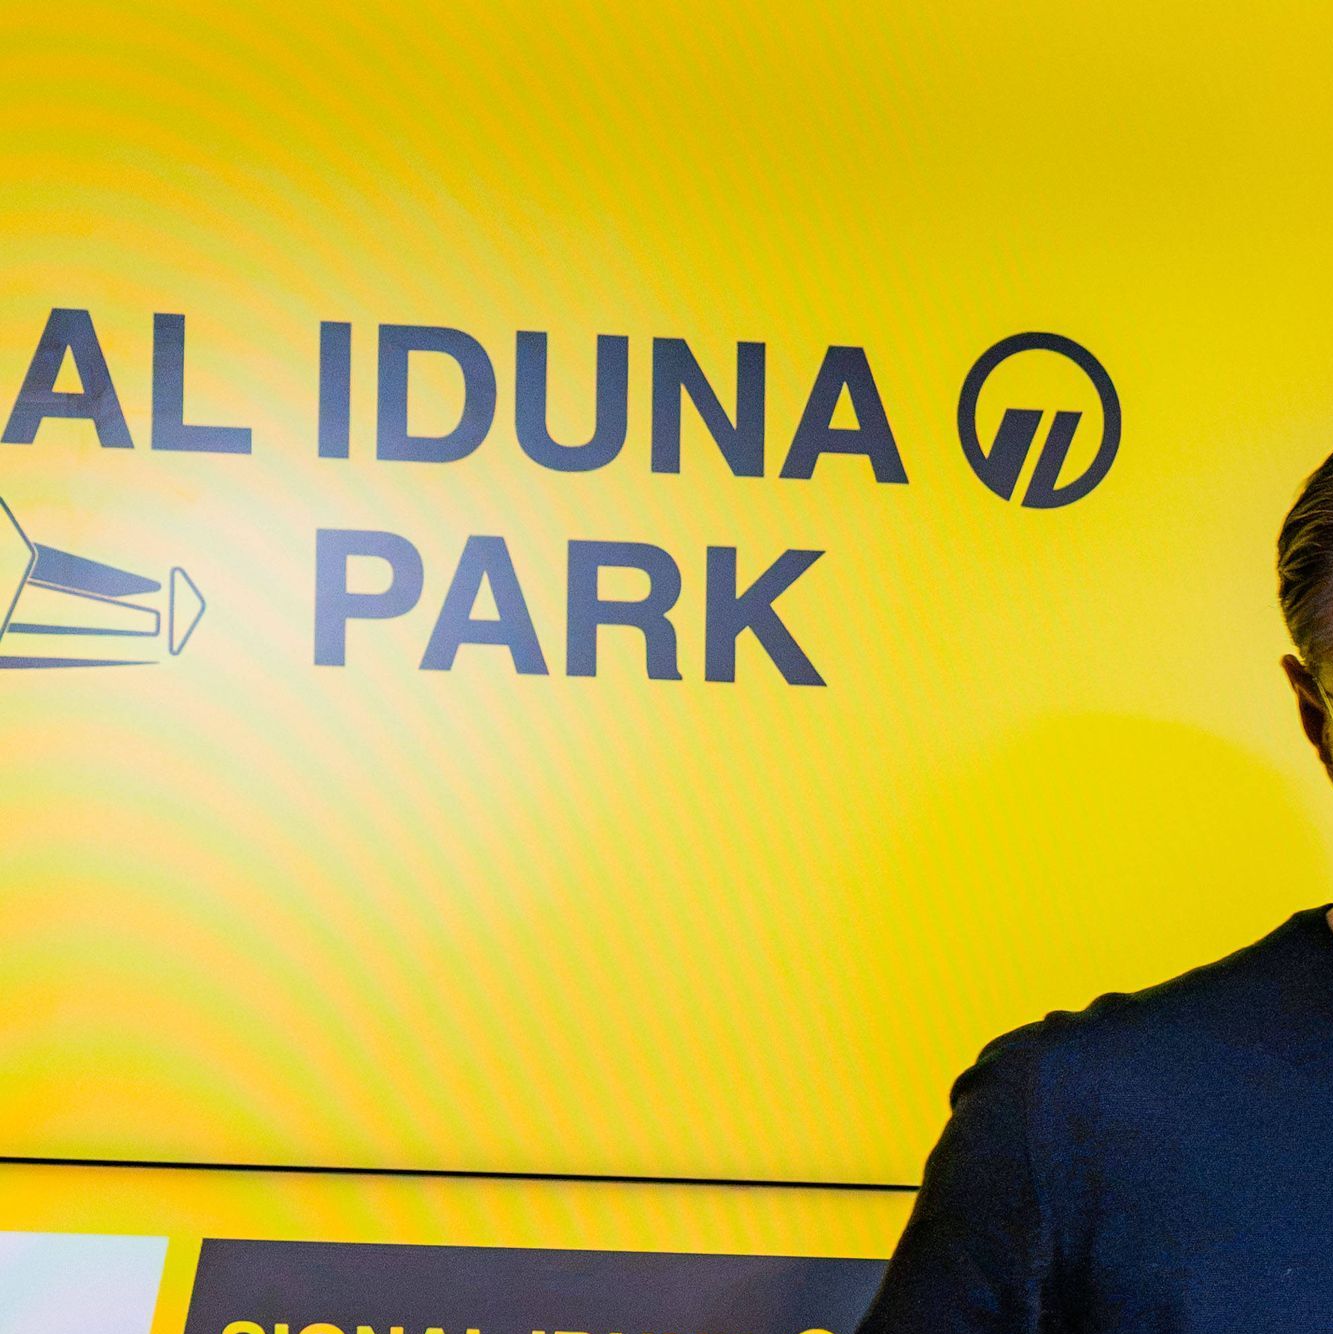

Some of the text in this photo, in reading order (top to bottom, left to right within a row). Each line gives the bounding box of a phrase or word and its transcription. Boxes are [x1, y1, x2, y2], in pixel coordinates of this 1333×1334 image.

[0, 308, 909, 484] AL IDUNA
[312, 527, 828, 687] PARK
